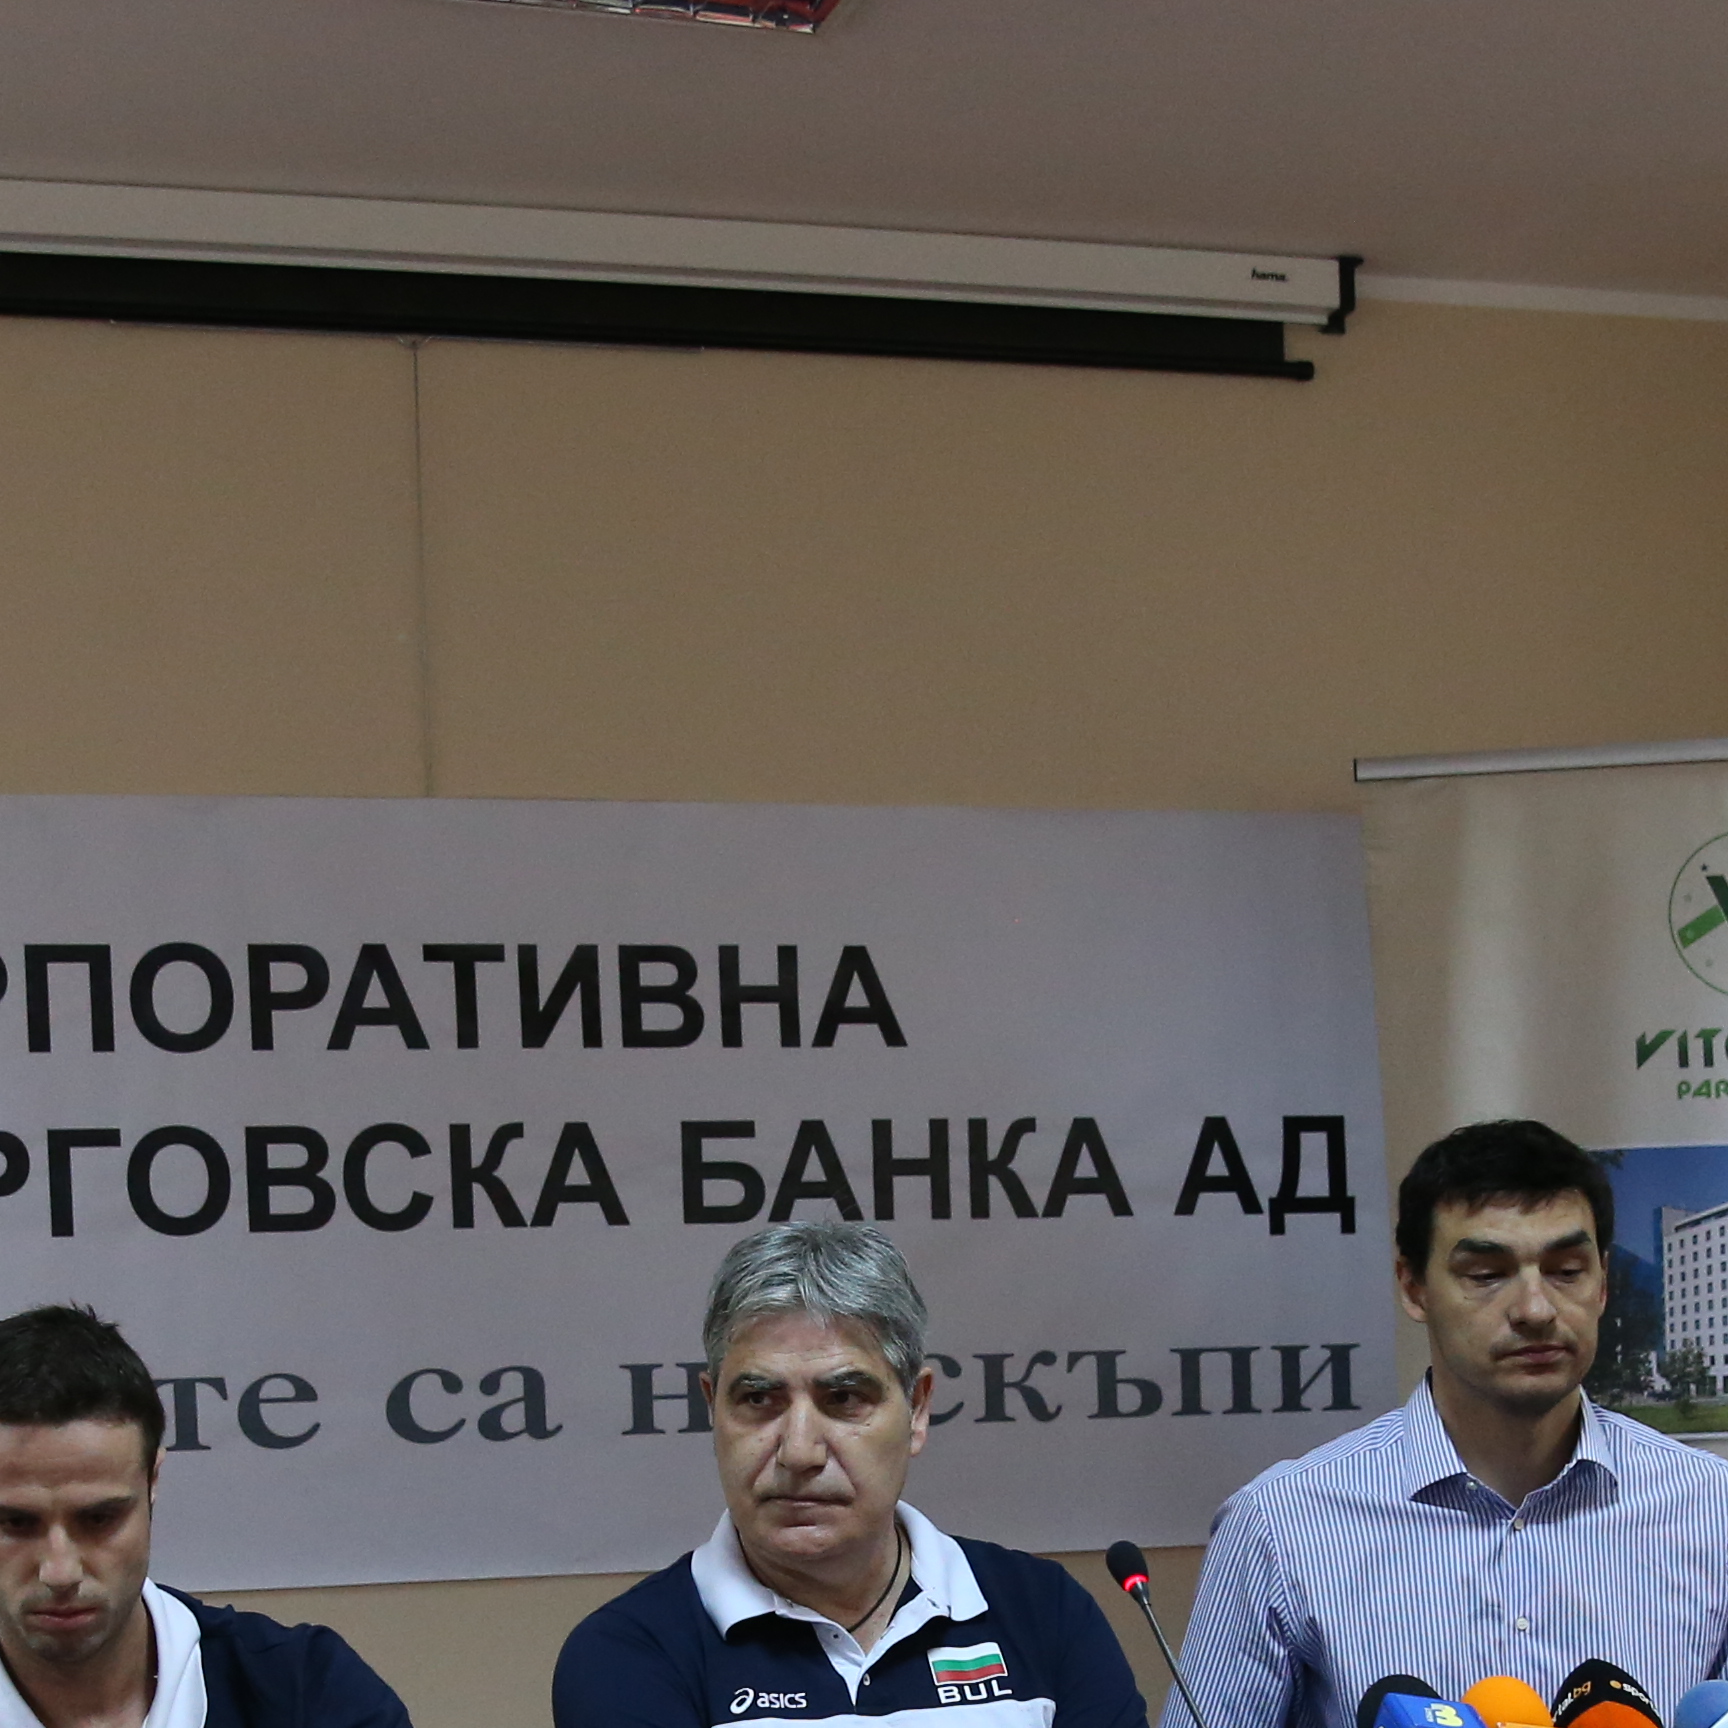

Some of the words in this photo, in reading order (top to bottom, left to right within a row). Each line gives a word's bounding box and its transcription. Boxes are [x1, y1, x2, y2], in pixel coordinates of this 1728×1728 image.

[680, 1117, 1134, 1224] БАНКА
[1174, 1115, 1356, 1236] АД
[385, 1364, 563, 1444] са
[757, 1692, 807, 1709] asics
[938, 1679, 1013, 1704] BUL
